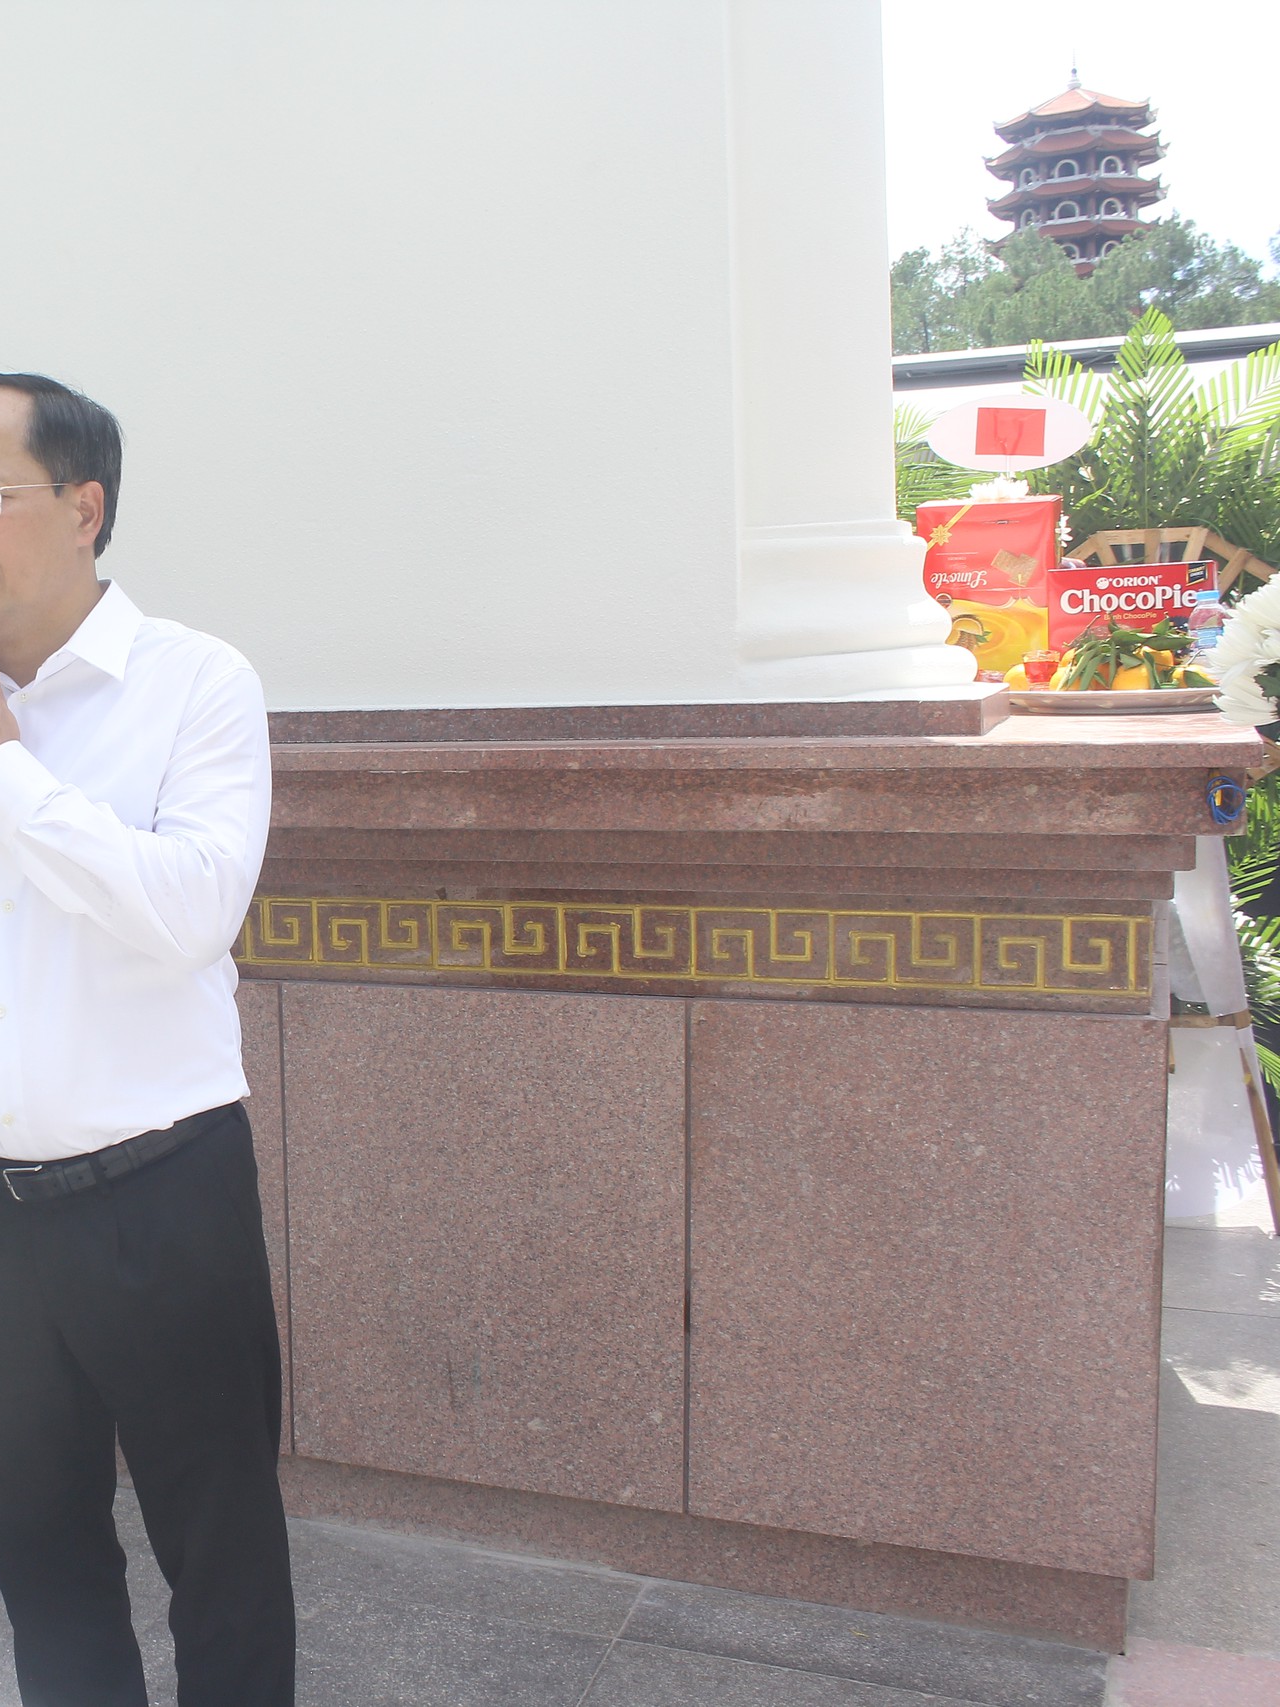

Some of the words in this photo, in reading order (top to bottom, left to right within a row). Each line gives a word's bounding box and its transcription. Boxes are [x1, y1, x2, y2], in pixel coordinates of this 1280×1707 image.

[1112, 575, 1158, 587] ORION
[1060, 584, 1198, 614] ChocoPie
[1122, 612, 1157, 620] ChocoPie
